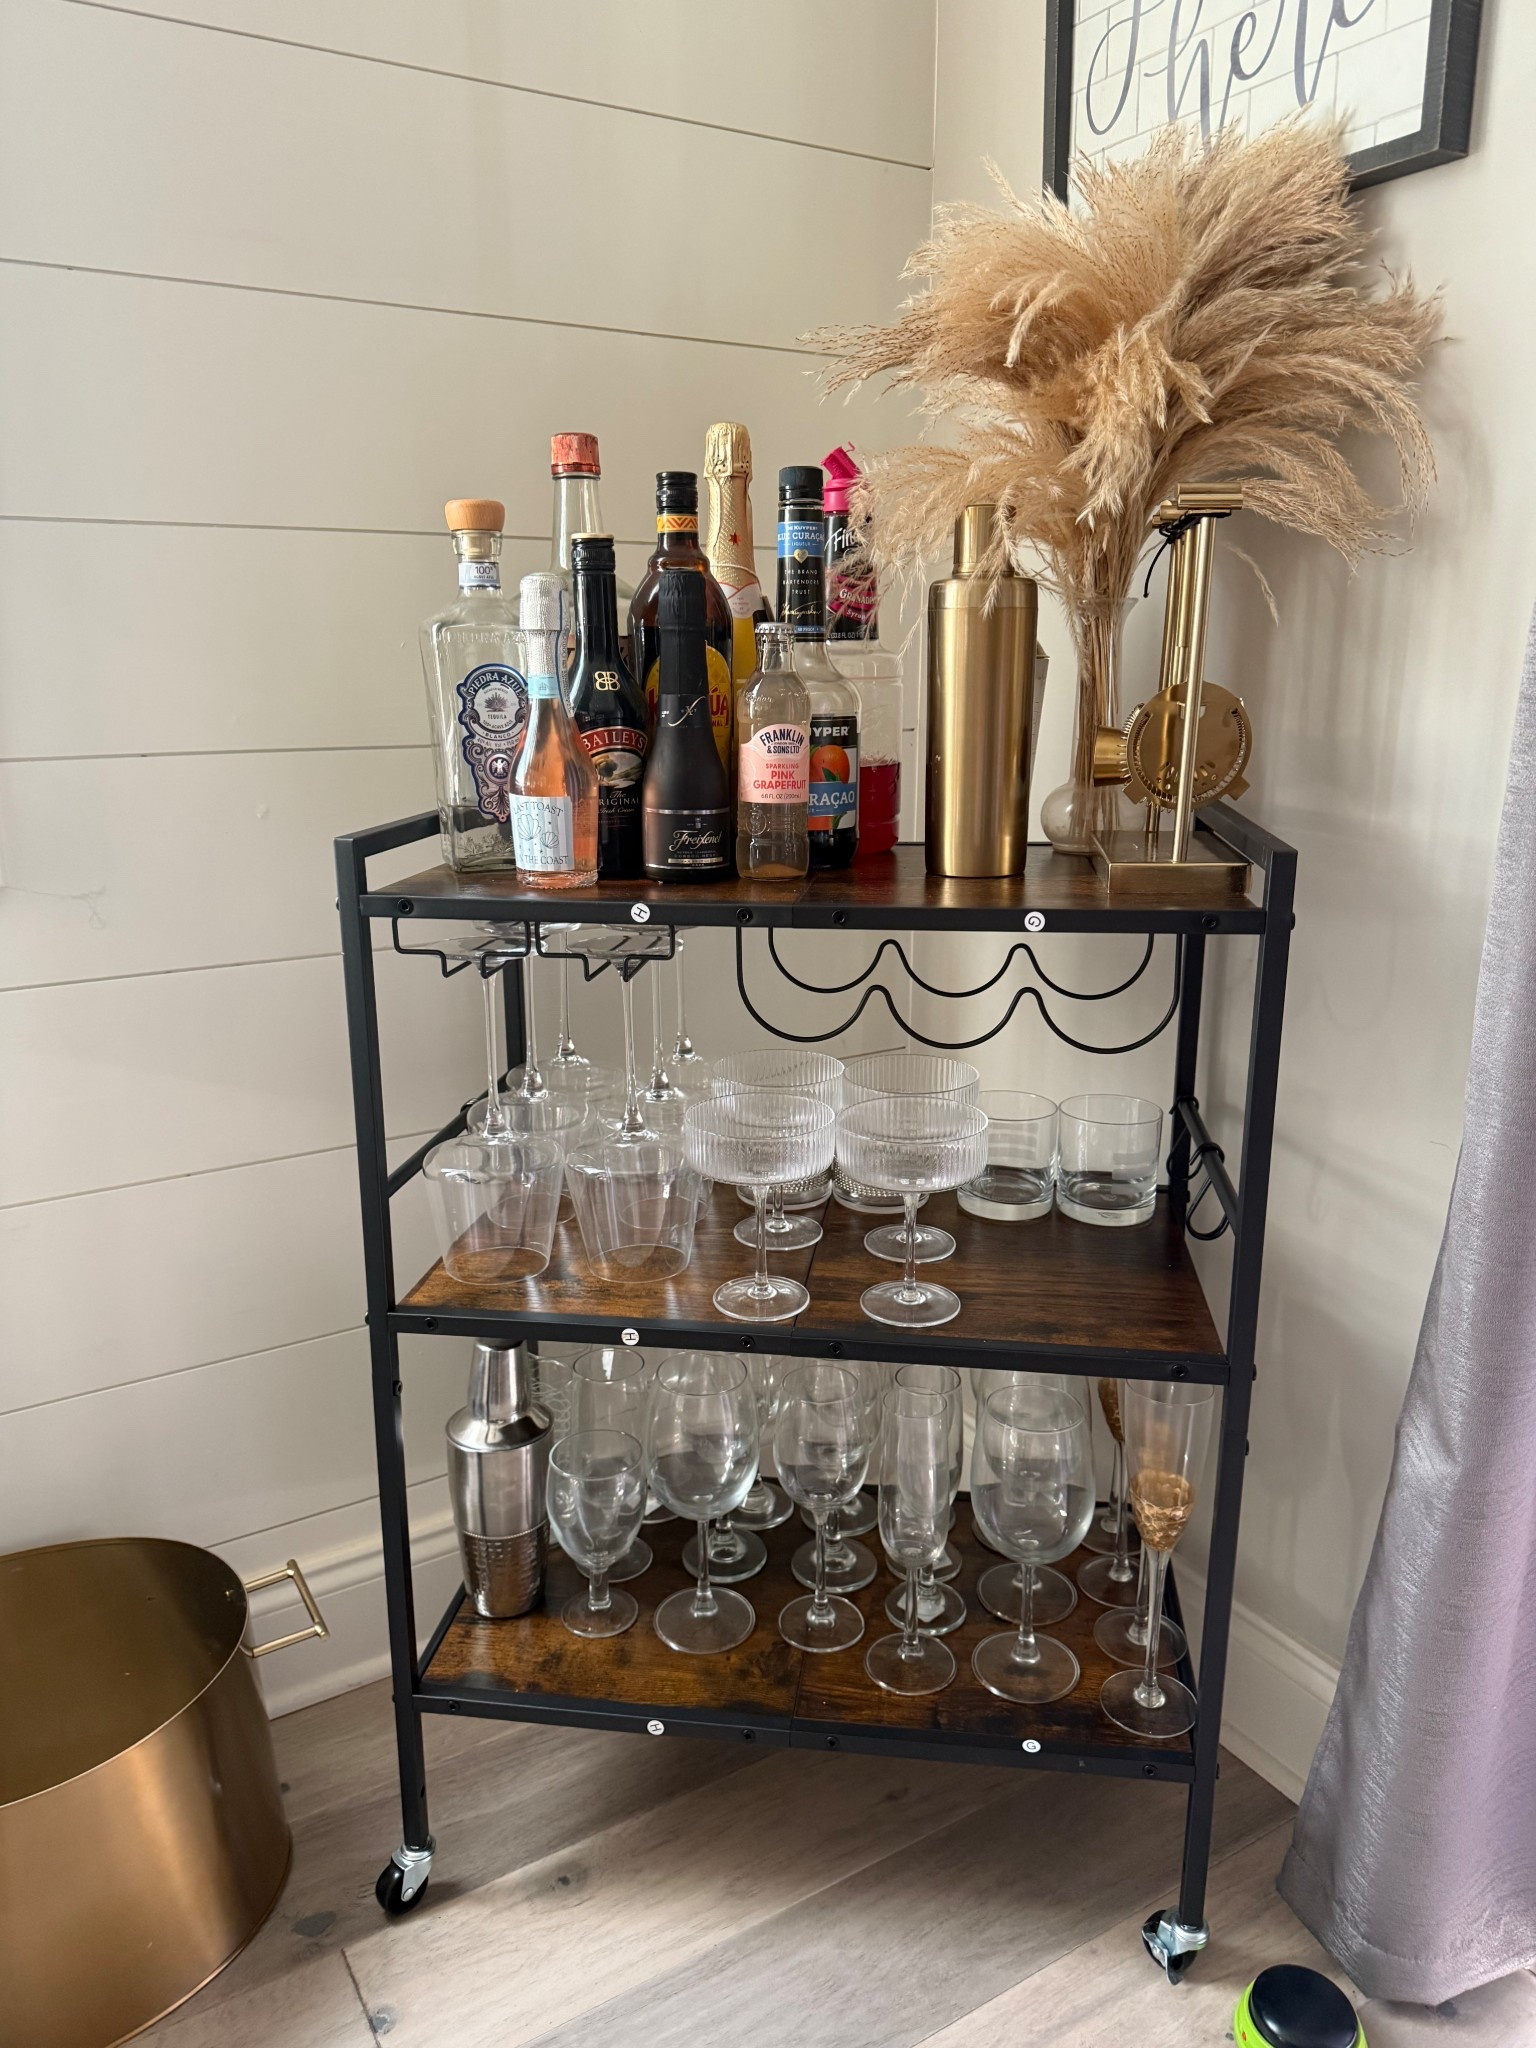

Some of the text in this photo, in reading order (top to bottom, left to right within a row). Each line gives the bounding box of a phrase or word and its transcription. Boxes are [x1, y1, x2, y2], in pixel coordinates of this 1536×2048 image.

[468, 671, 524, 698] PIEDRA AZUL
[759, 728, 805, 747] FRANKLIN
[810, 726, 849, 738] YPER
[583, 731, 645, 750] BAILEYS
[767, 745, 800, 754] & SONS LTD
[770, 770, 795, 780] PINK
[753, 779, 807, 790] GRAPEFRUIT
[609, 790, 627, 799] The
[809, 790, 855, 809] RAÇAO
[598, 797, 640, 806] RIGINAL
[530, 801, 564, 817] TOAST
[524, 854, 539, 865] THE
[540, 855, 569, 865] COAST
[633, 906, 648, 920] H
[1028, 915, 1042, 928] G
[623, 1332, 637, 1341] H
[649, 1723, 662, 1732] H
[1026, 1741, 1037, 1751] G
